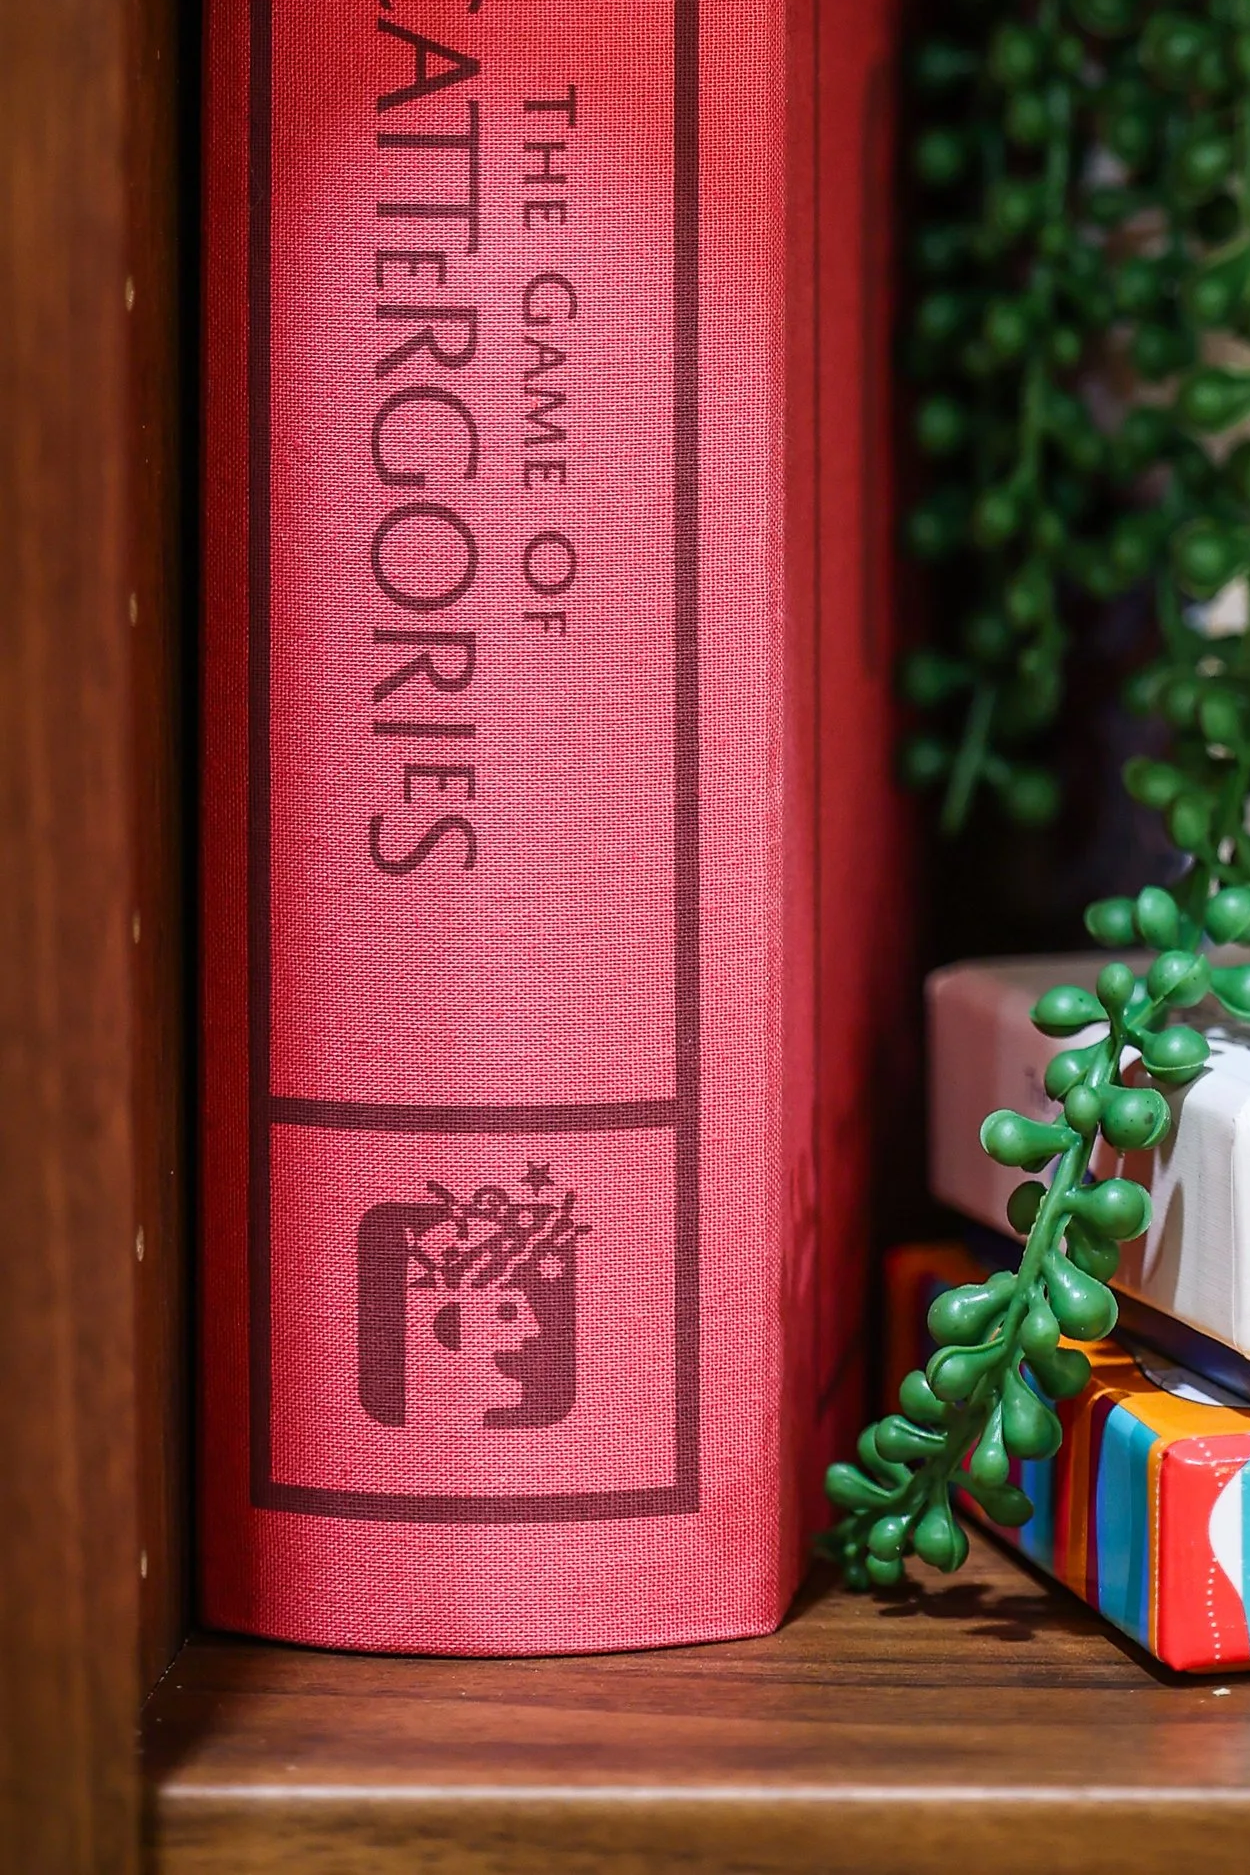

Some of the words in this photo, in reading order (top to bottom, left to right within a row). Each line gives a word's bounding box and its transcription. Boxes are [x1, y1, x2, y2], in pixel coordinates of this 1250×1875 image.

[522, 84, 578, 230] THE
[522, 272, 578, 490] GAME
[522, 530, 578, 636] OF
